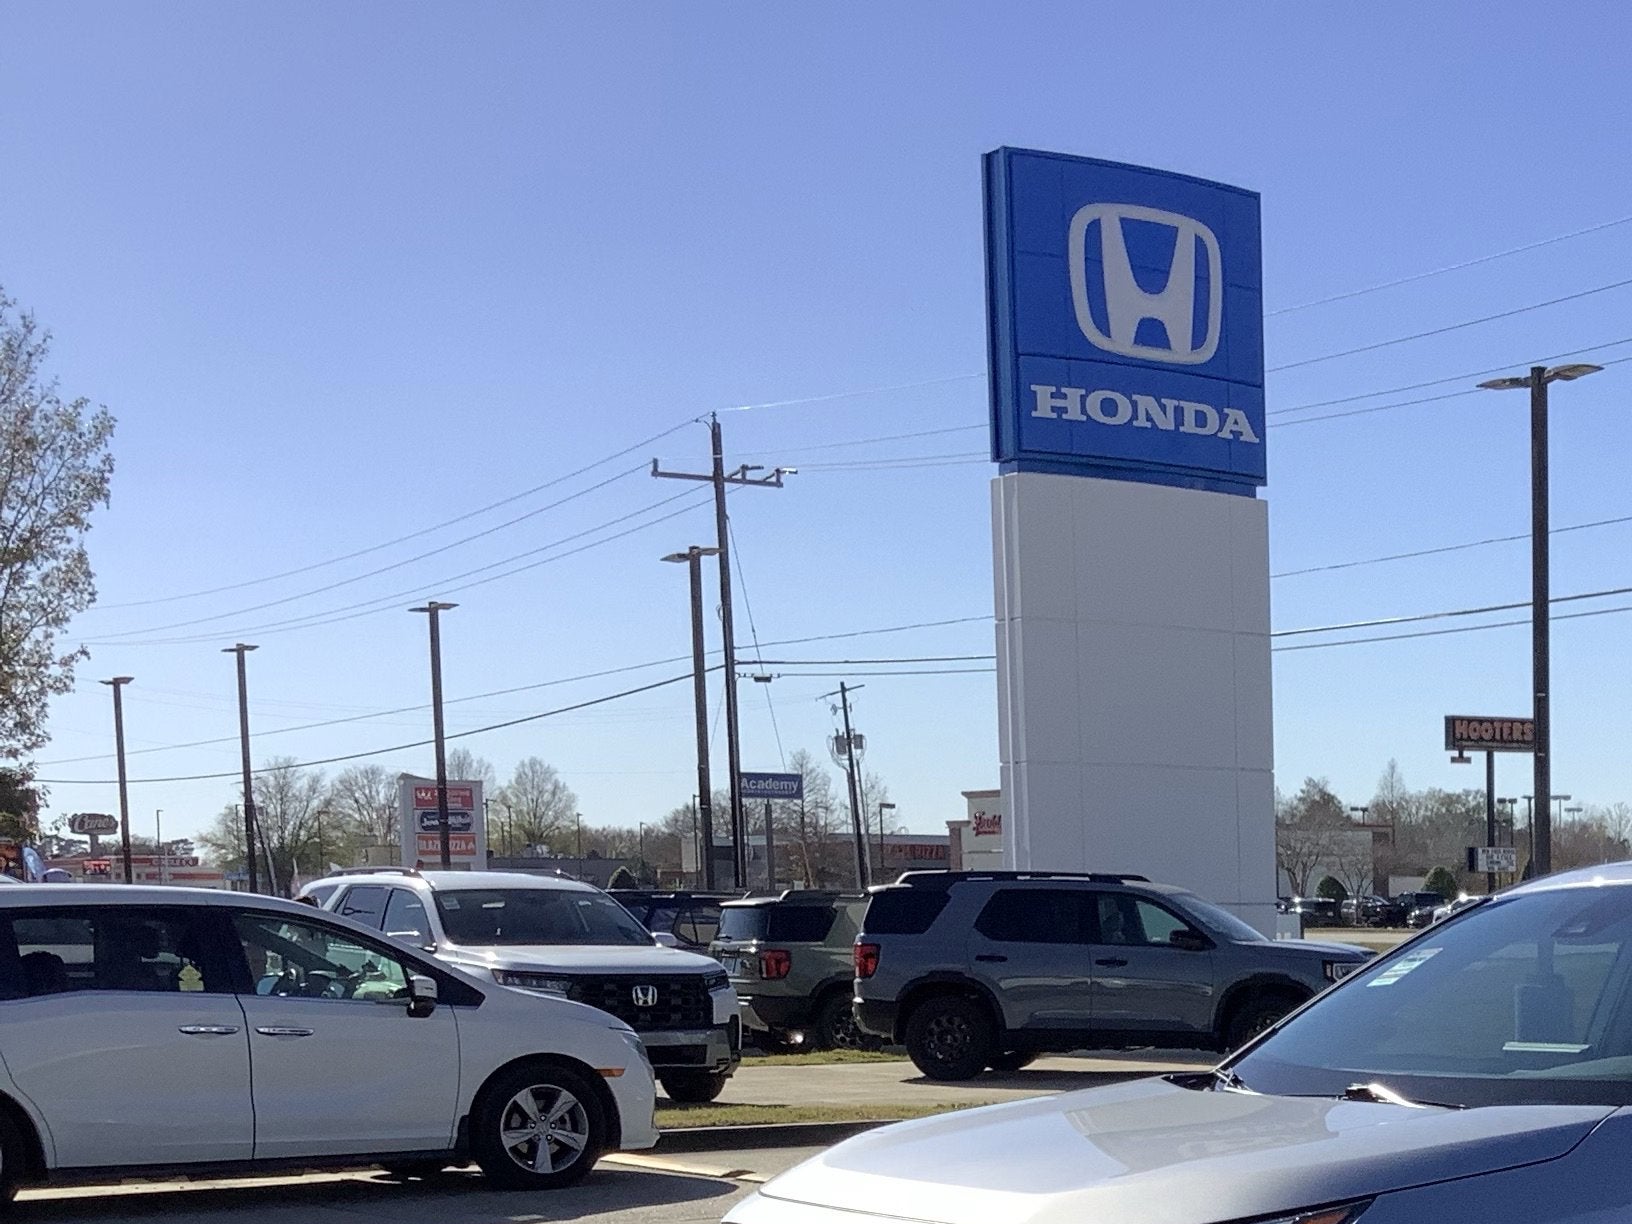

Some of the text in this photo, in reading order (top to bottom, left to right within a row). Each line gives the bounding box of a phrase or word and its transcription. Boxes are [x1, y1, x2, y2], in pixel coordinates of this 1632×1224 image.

[1030, 384, 1259, 443] HONDA
[1454, 720, 1534, 740] HOOTERS
[741, 778, 799, 794] Academy
